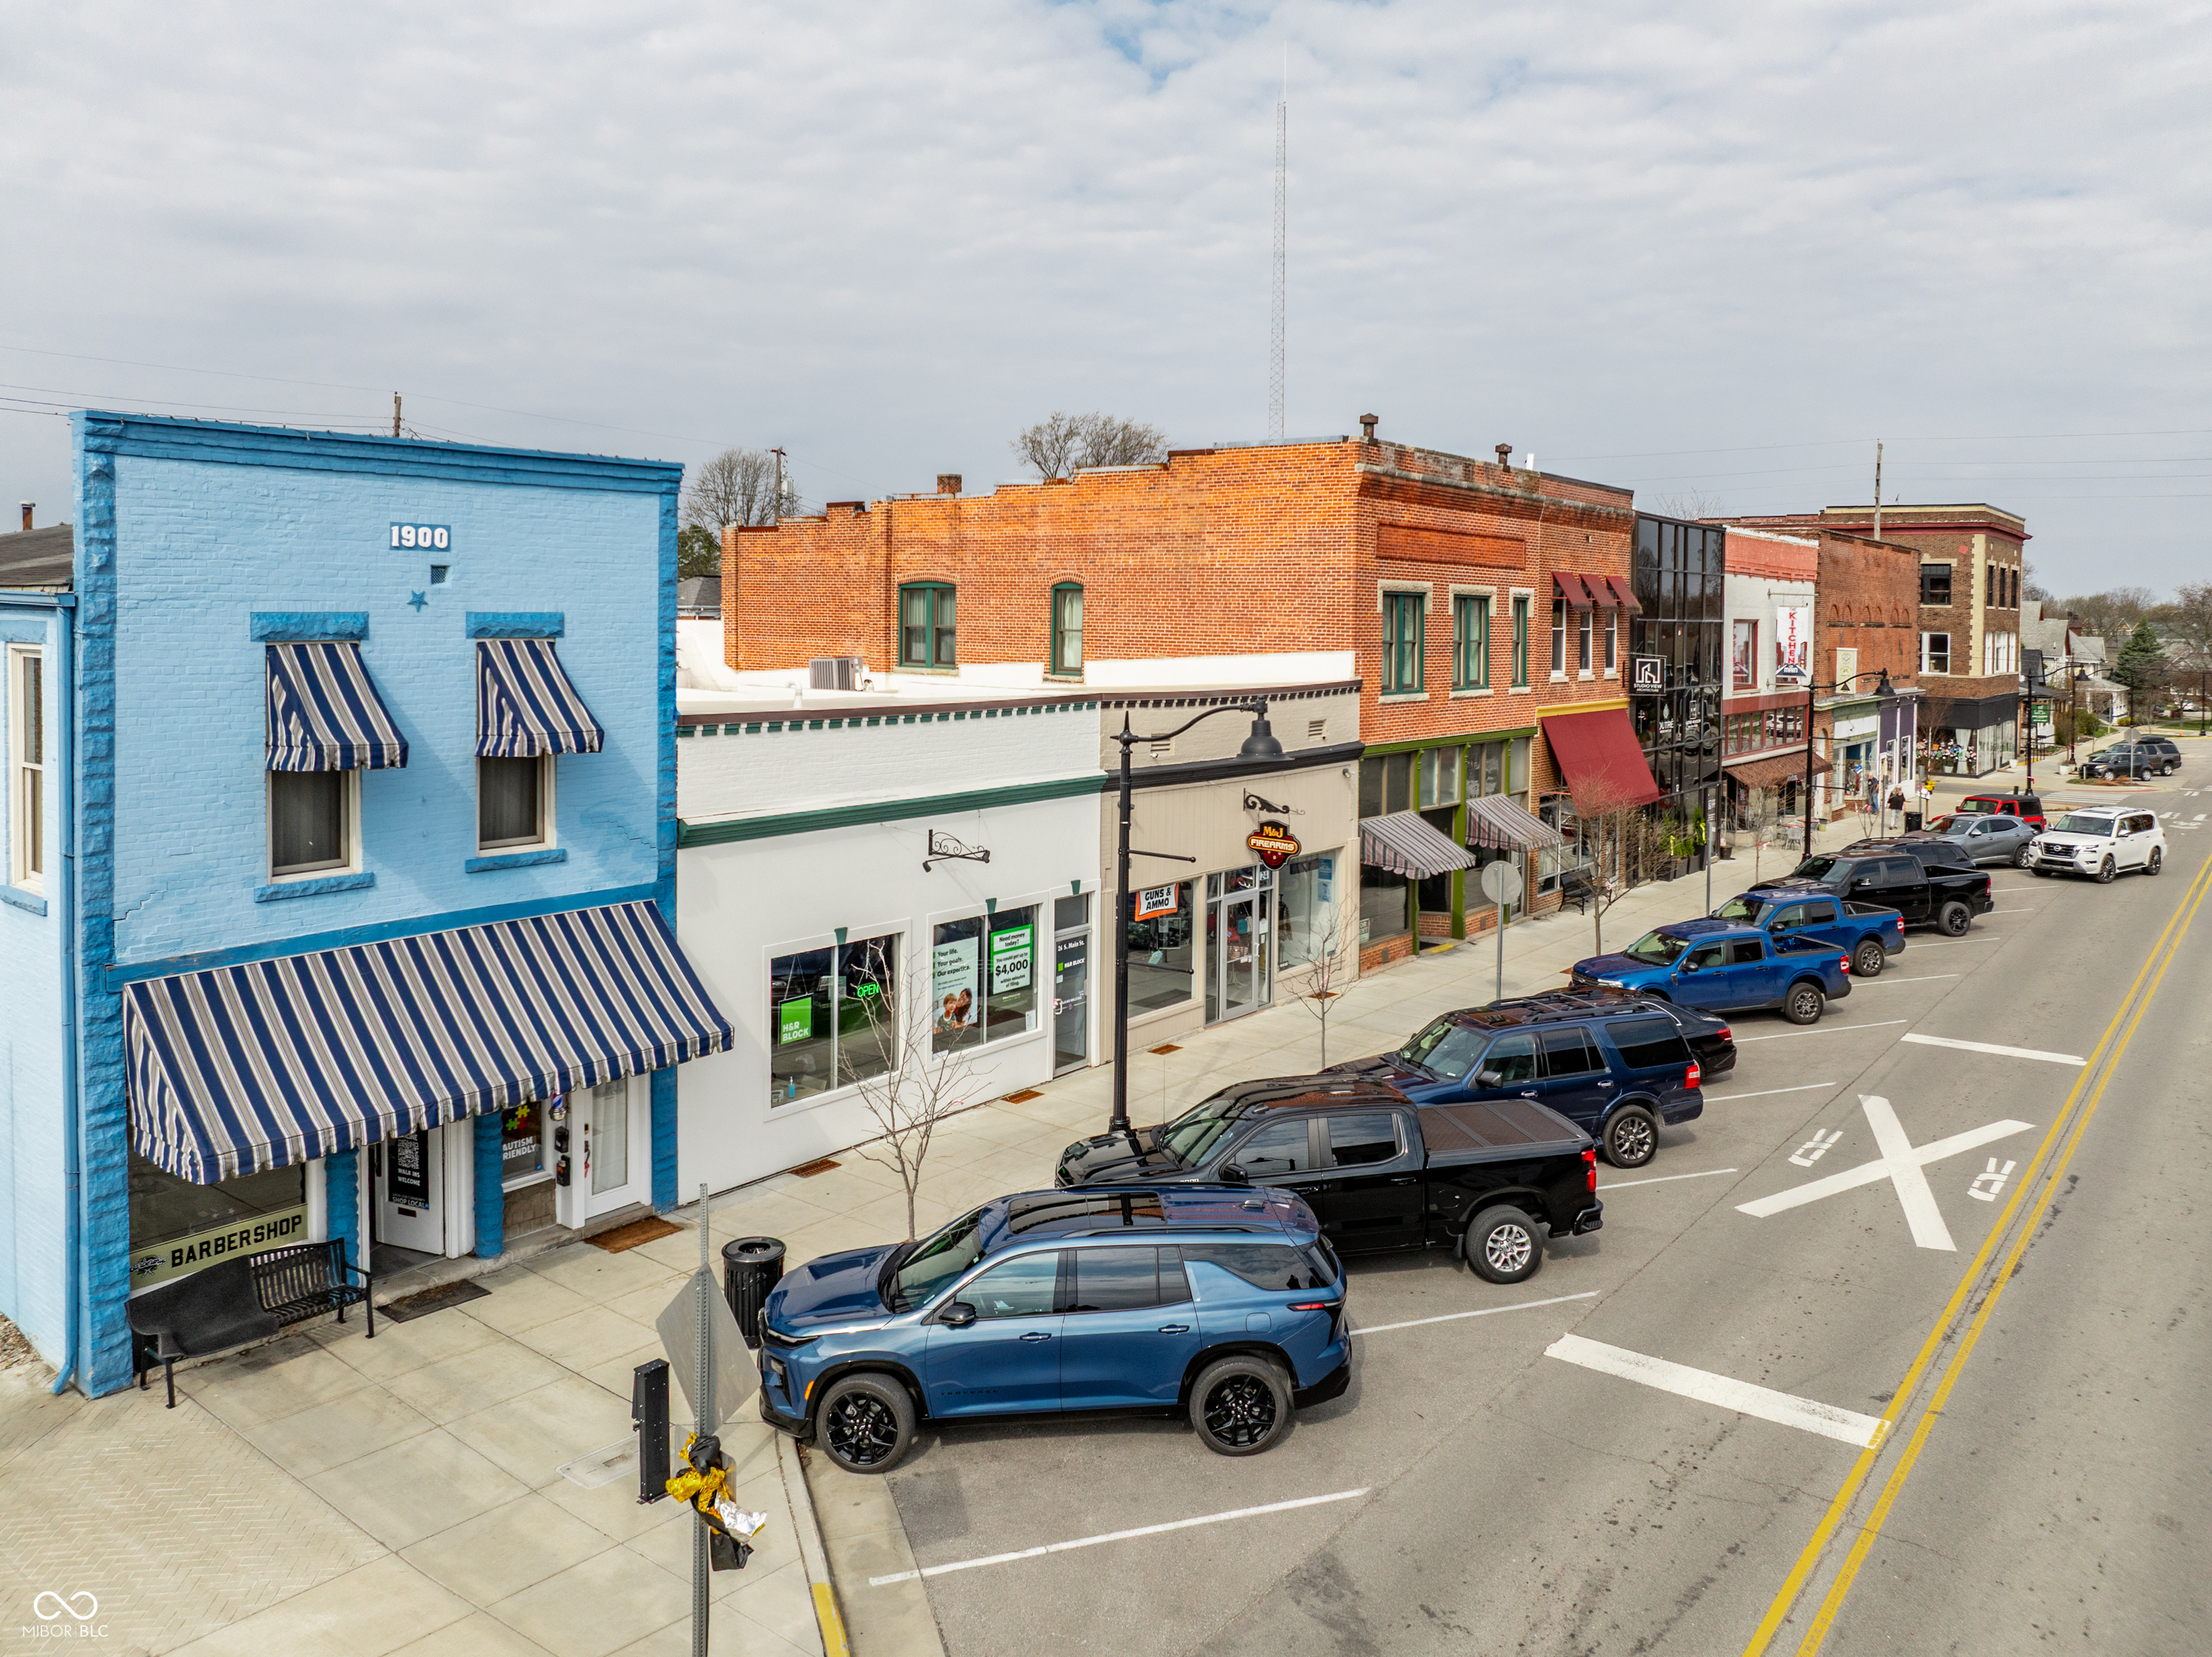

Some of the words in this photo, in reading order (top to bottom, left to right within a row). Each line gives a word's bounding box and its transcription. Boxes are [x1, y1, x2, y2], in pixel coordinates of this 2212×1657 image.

[391, 525, 448, 549] 1900
[1788, 612, 1798, 664] KITCHEN
[1262, 826, 1283, 838] M&J
[1251, 838, 1295, 851] FIREARMS
[1145, 889, 1164, 901] GUNS
[1166, 887, 1171, 896] &
[1146, 897, 1169, 910] AMMO
[1068, 941, 1079, 949] Main
[949, 957, 963, 966] goals.
[995, 959, 1028, 977] $4,000
[1073, 958, 1085, 966] BLOCK
[947, 965, 970, 975] expertise.
[857, 984, 879, 997] OPEN
[783, 1021, 799, 1032] H&R
[783, 1027, 809, 1041] BLOCK
[503, 1136, 532, 1152] AUTISM
[503, 1144, 536, 1161] RIENDLY
[398, 1176, 420, 1186] WELCOME
[392, 1196, 407, 1204] SHOP
[408, 1199, 425, 1209] LOCAL
[171, 1215, 302, 1268] BARBERSHOP
